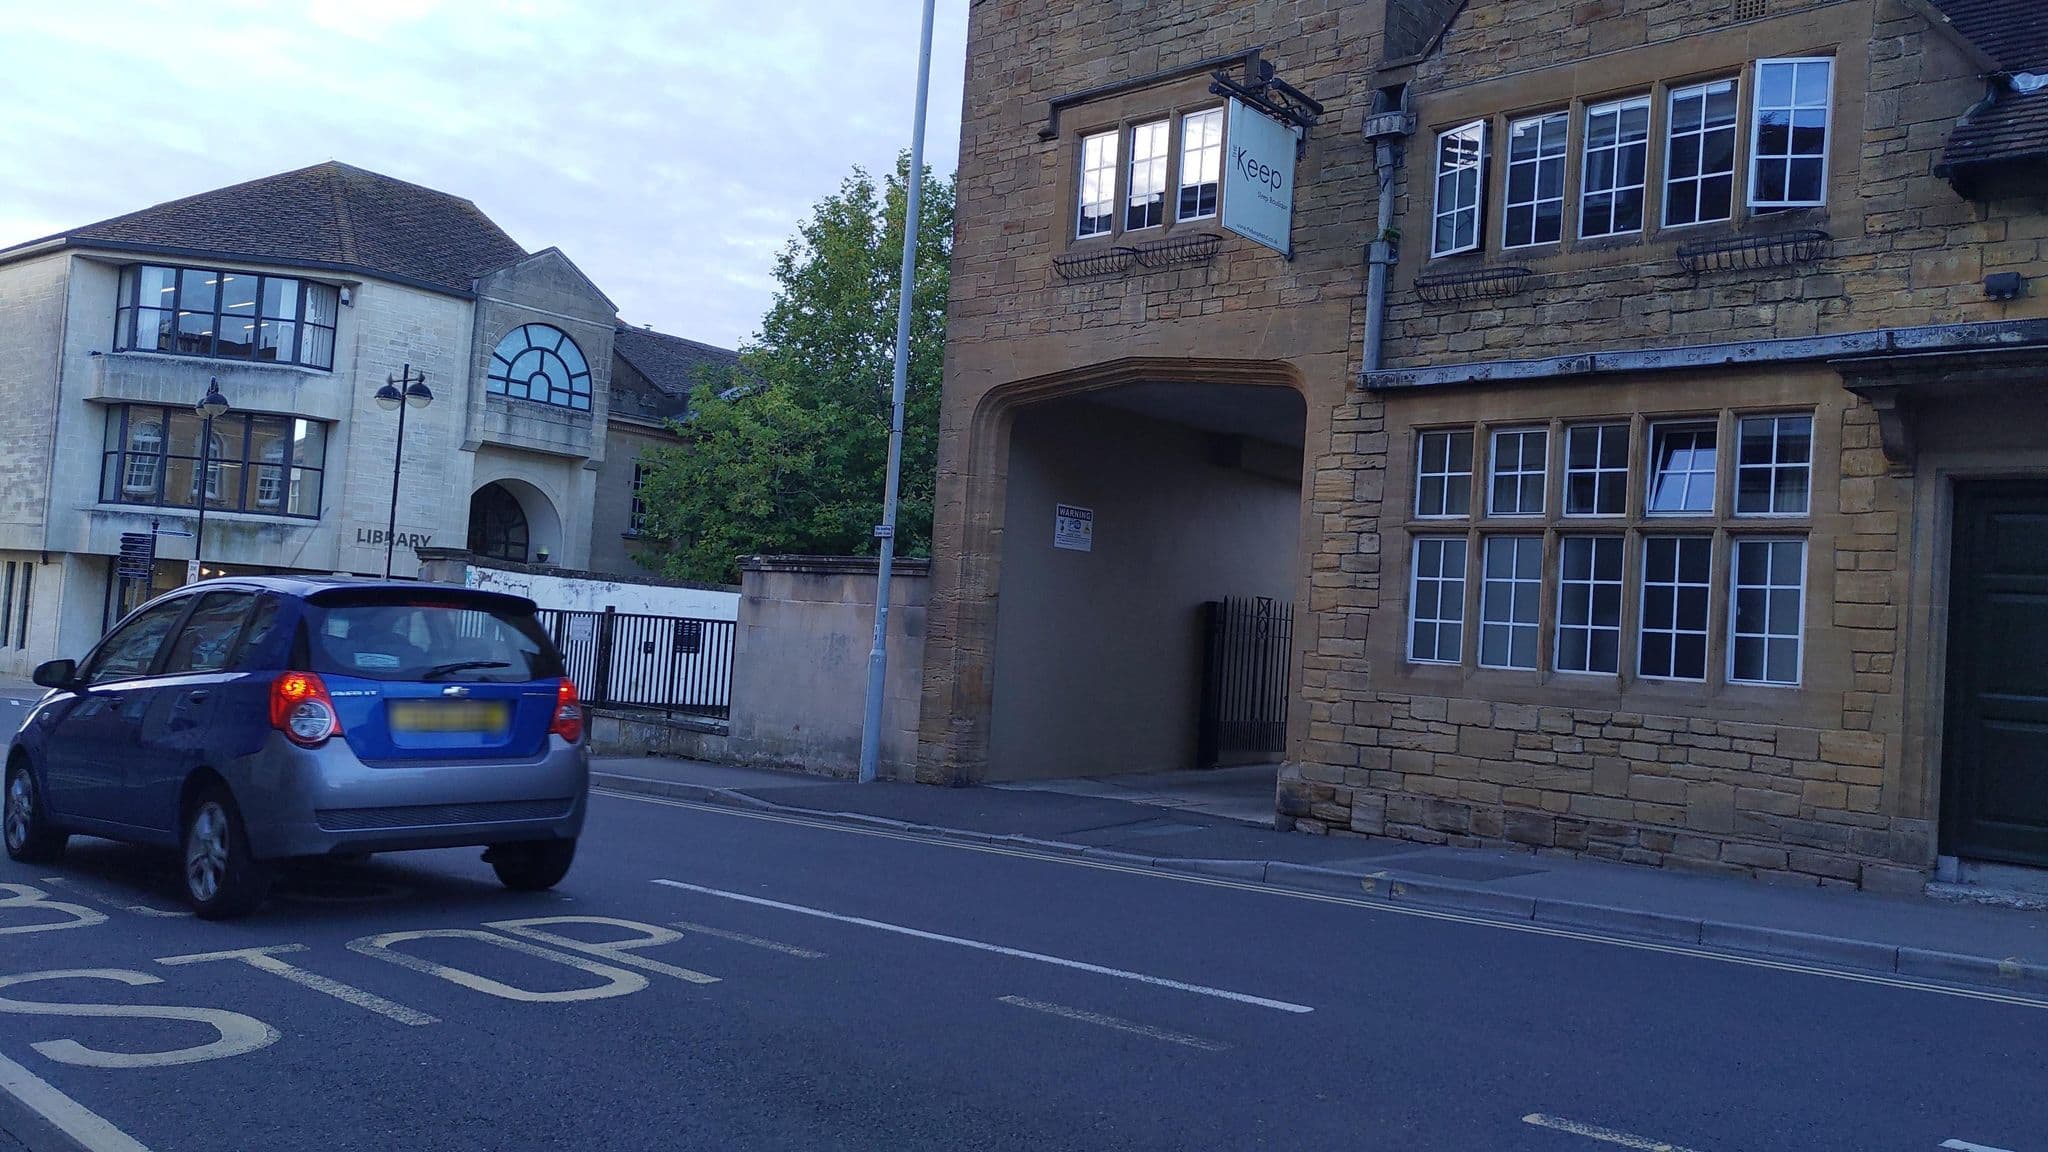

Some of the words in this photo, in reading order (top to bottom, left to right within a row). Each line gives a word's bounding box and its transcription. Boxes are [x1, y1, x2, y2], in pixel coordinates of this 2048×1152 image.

[1237, 146, 1282, 193] Keep
[1060, 507, 1091, 520] WARNING
[356, 528, 432, 548] LIBRARY
[0, 916, 722, 1068] STOP
